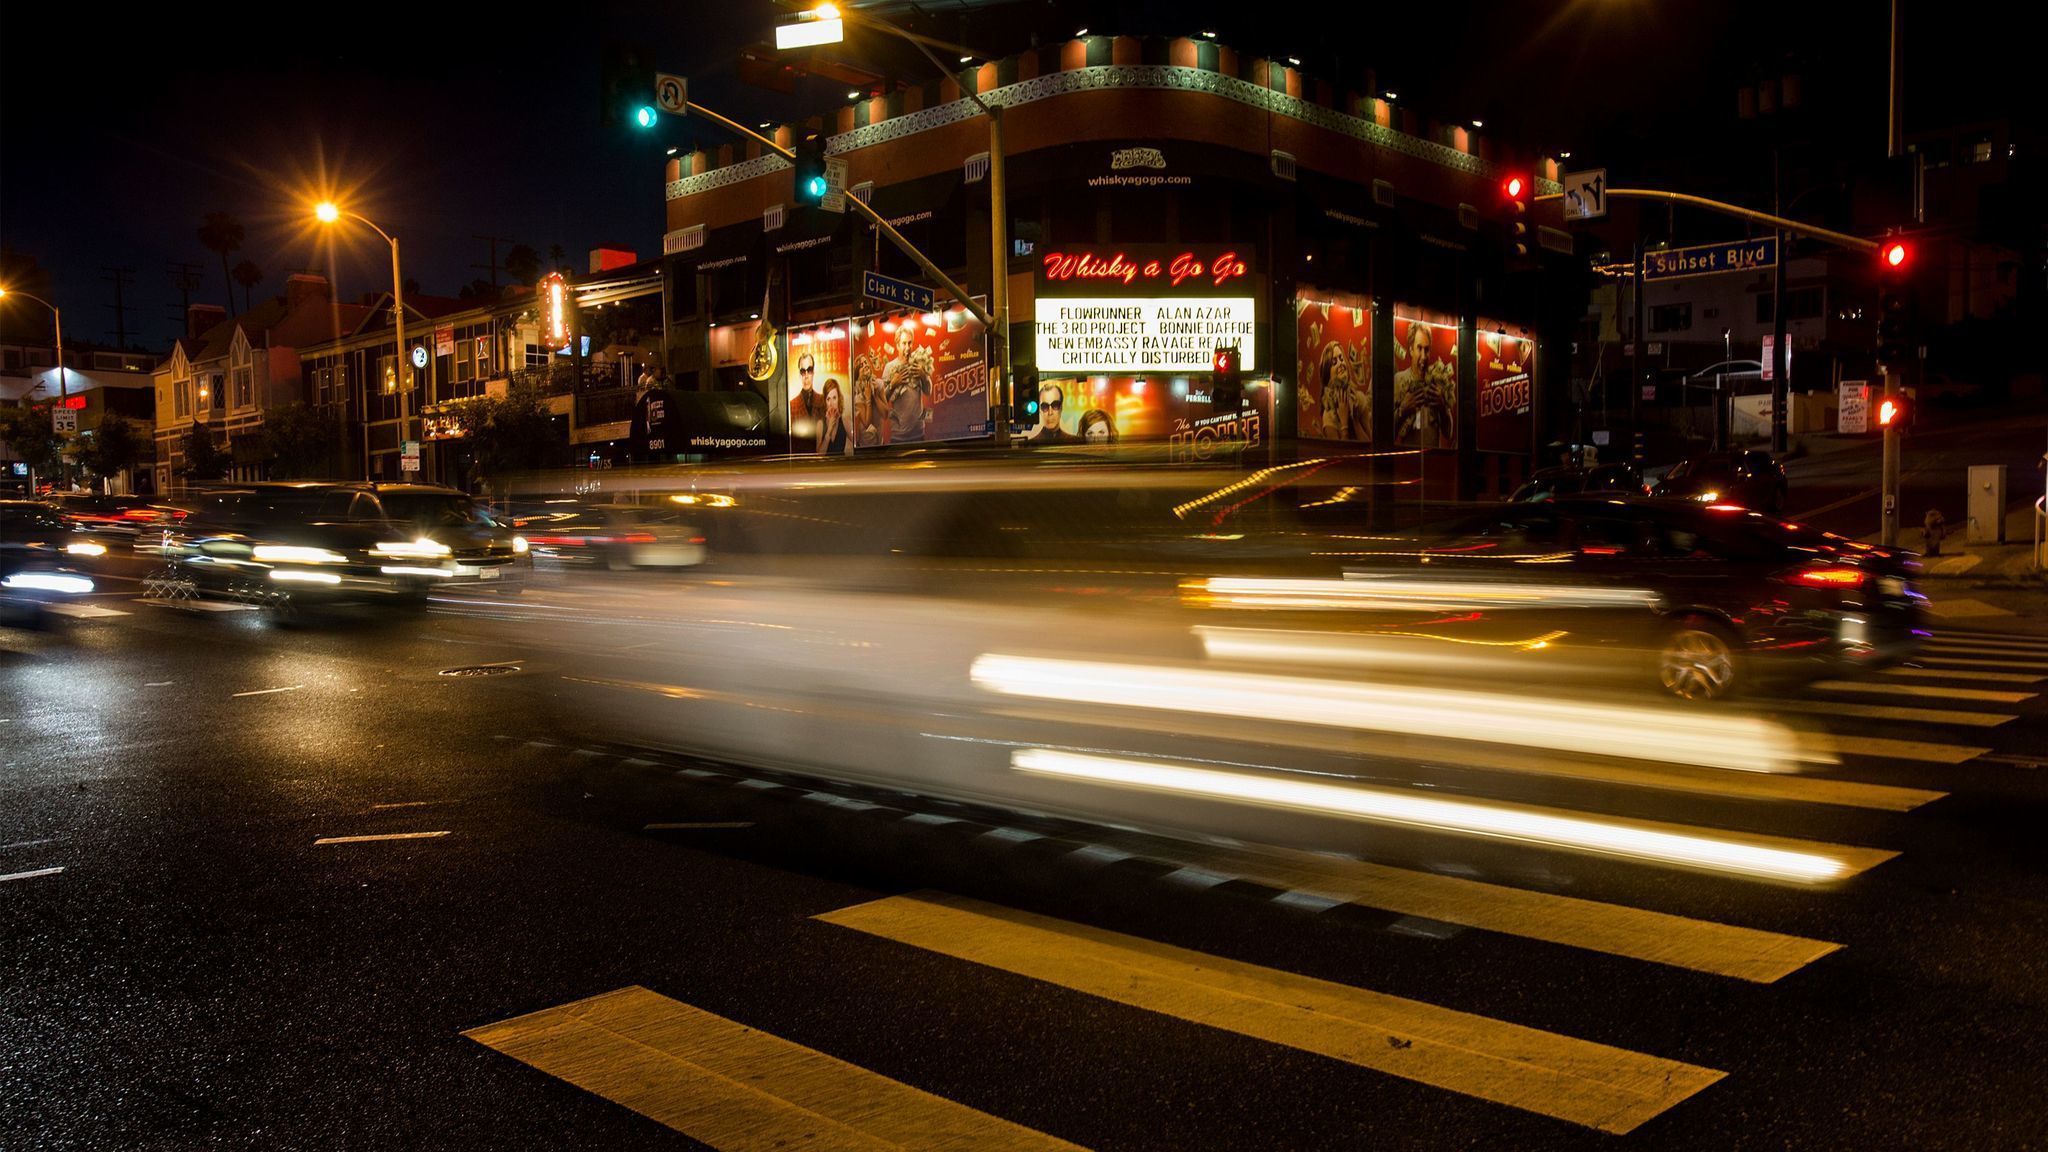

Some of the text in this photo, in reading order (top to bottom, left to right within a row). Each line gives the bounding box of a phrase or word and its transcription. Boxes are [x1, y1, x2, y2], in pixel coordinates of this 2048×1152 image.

[1088, 175, 1191, 186] whiskyagogo.com
[1657, 245, 1765, 273] Sunset Blvd
[1044, 251, 1248, 287] Whisky a Go Go
[868, 278, 916, 302] Clark St
[1060, 307, 1142, 320] FLOWRUNNER
[1157, 307, 1231, 320] ALAN AZAR
[1036, 322, 1058, 335] THE
[1090, 322, 1146, 335] PROJECT
[1160, 322, 1253, 334] BONNIE DAFFOE
[1048, 336, 1242, 350] NEW EMBASSY RAVAGE REALM
[1062, 351, 1210, 364] CRITICALLY DISTURBED
[933, 364, 985, 404] HOUSE
[1480, 379, 1529, 417] HOUSE
[56, 421, 76, 431] 35
[1174, 418, 1190, 431] The
[649, 439, 665, 450] 8901
[690, 436, 767, 448] whiskyagogo.com
